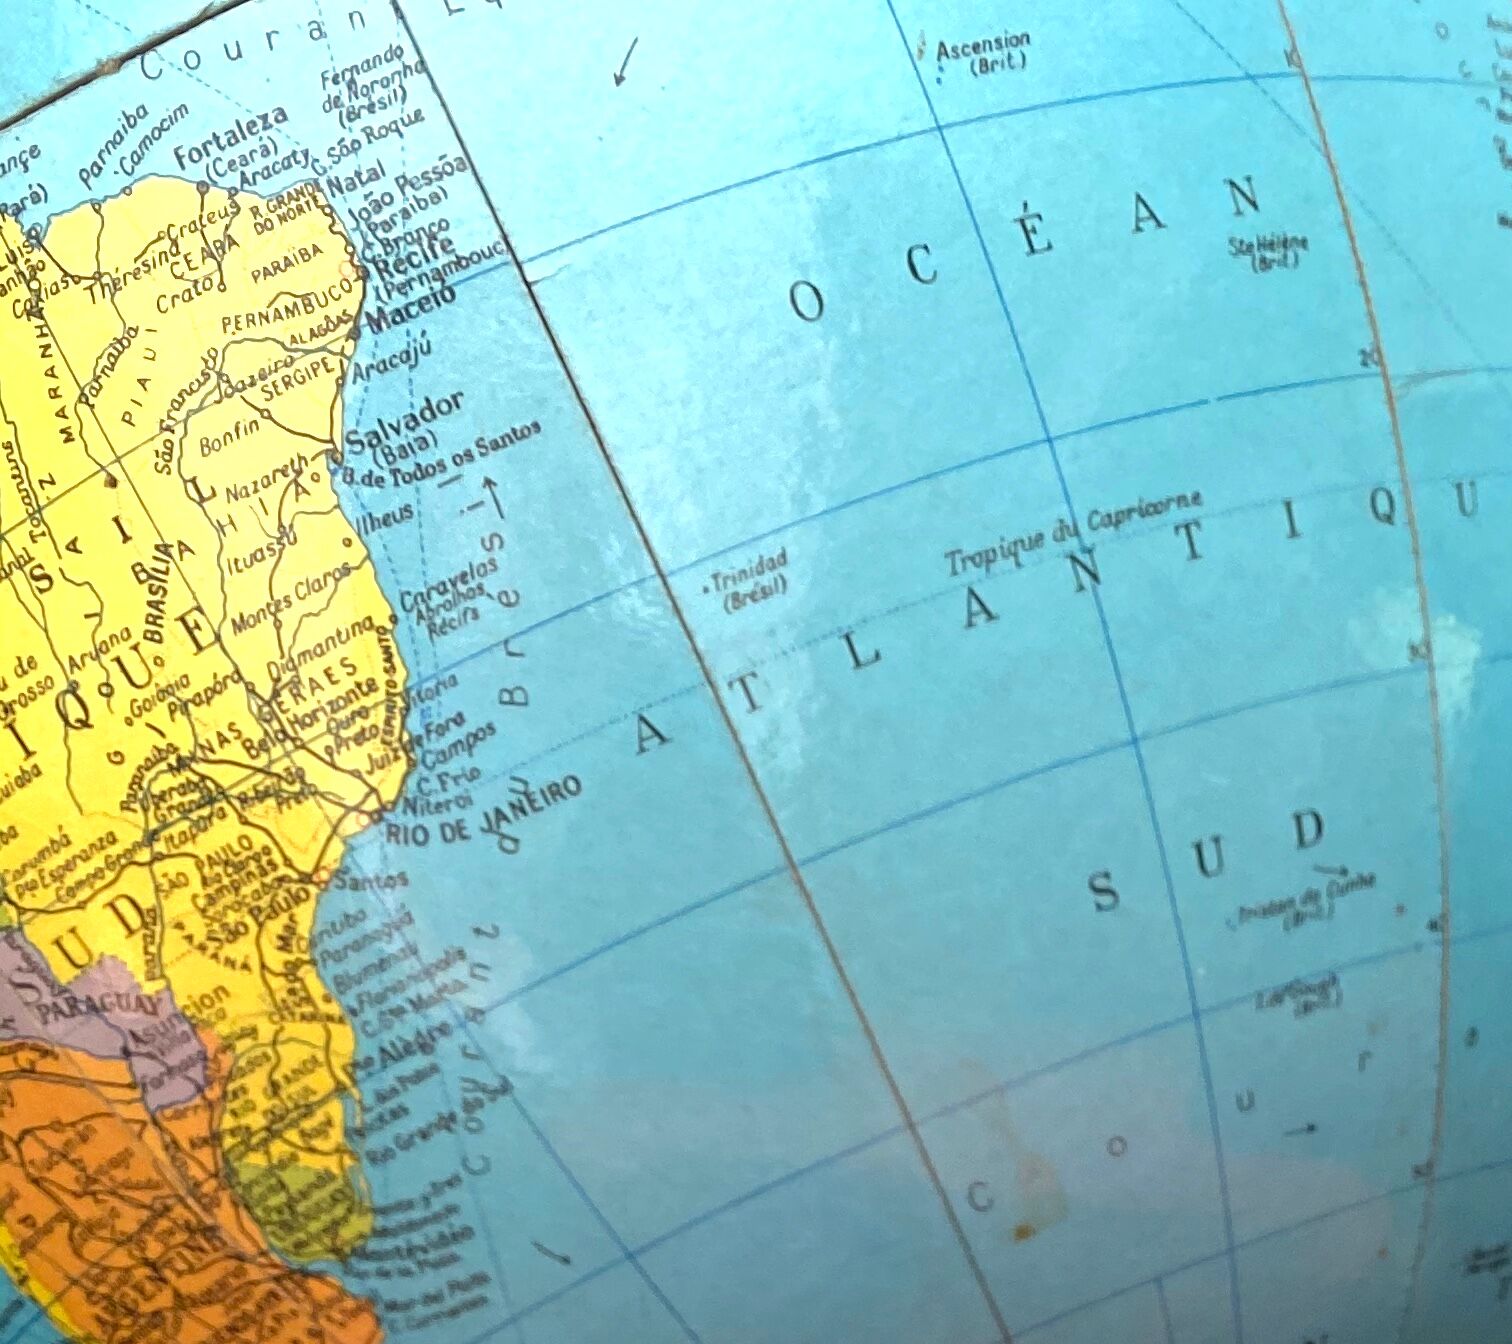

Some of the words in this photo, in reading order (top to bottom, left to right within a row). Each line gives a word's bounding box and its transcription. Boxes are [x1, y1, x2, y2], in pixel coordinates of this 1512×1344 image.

[321, 43, 404, 90] Fernando
[937, 30, 1031, 61] Ascension
[347, 59, 427, 103] Noronha
[79, 104, 149, 190] Parnaiba
[119, 103, 190, 177] Camocim
[173, 106, 289, 171] Fortaleza
[360, 108, 425, 146] Roque
[206, 136, 278, 184] (Ceará)
[240, 148, 310, 189] Aracaty
[327, 158, 387, 199] Natal
[253, 218, 275, 236] DO
[348, 190, 394, 231] João
[375, 237, 456, 283] Recife
[789, 175, 1260, 323] OCÉAN
[157, 275, 213, 314] Crato
[221, 277, 353, 332] PERNAMBUCO
[260, 356, 335, 402] SERGIPE
[199, 418, 260, 458] Bonfin
[344, 391, 465, 456] Salvador
[361, 469, 385, 488] de
[391, 458, 447, 488] Todos
[452, 447, 474, 467] os
[475, 420, 542, 457] Santos
[354, 503, 414, 537] Ilheus
[944, 532, 1045, 578] Tropique
[1052, 517, 1081, 543] du
[1087, 488, 1204, 532] Capricorne
[295, 561, 352, 600] Claros
[711, 546, 788, 591] Trinidad
[286, 676, 380, 736] Horizonte
[421, 721, 497, 772] Campos
[0, 762, 42, 800] uiaba
[386, 823, 430, 848] RIO
[439, 818, 473, 845] DE
[479, 774, 583, 835] JANEIRO
[1087, 806, 1325, 912] SUD
